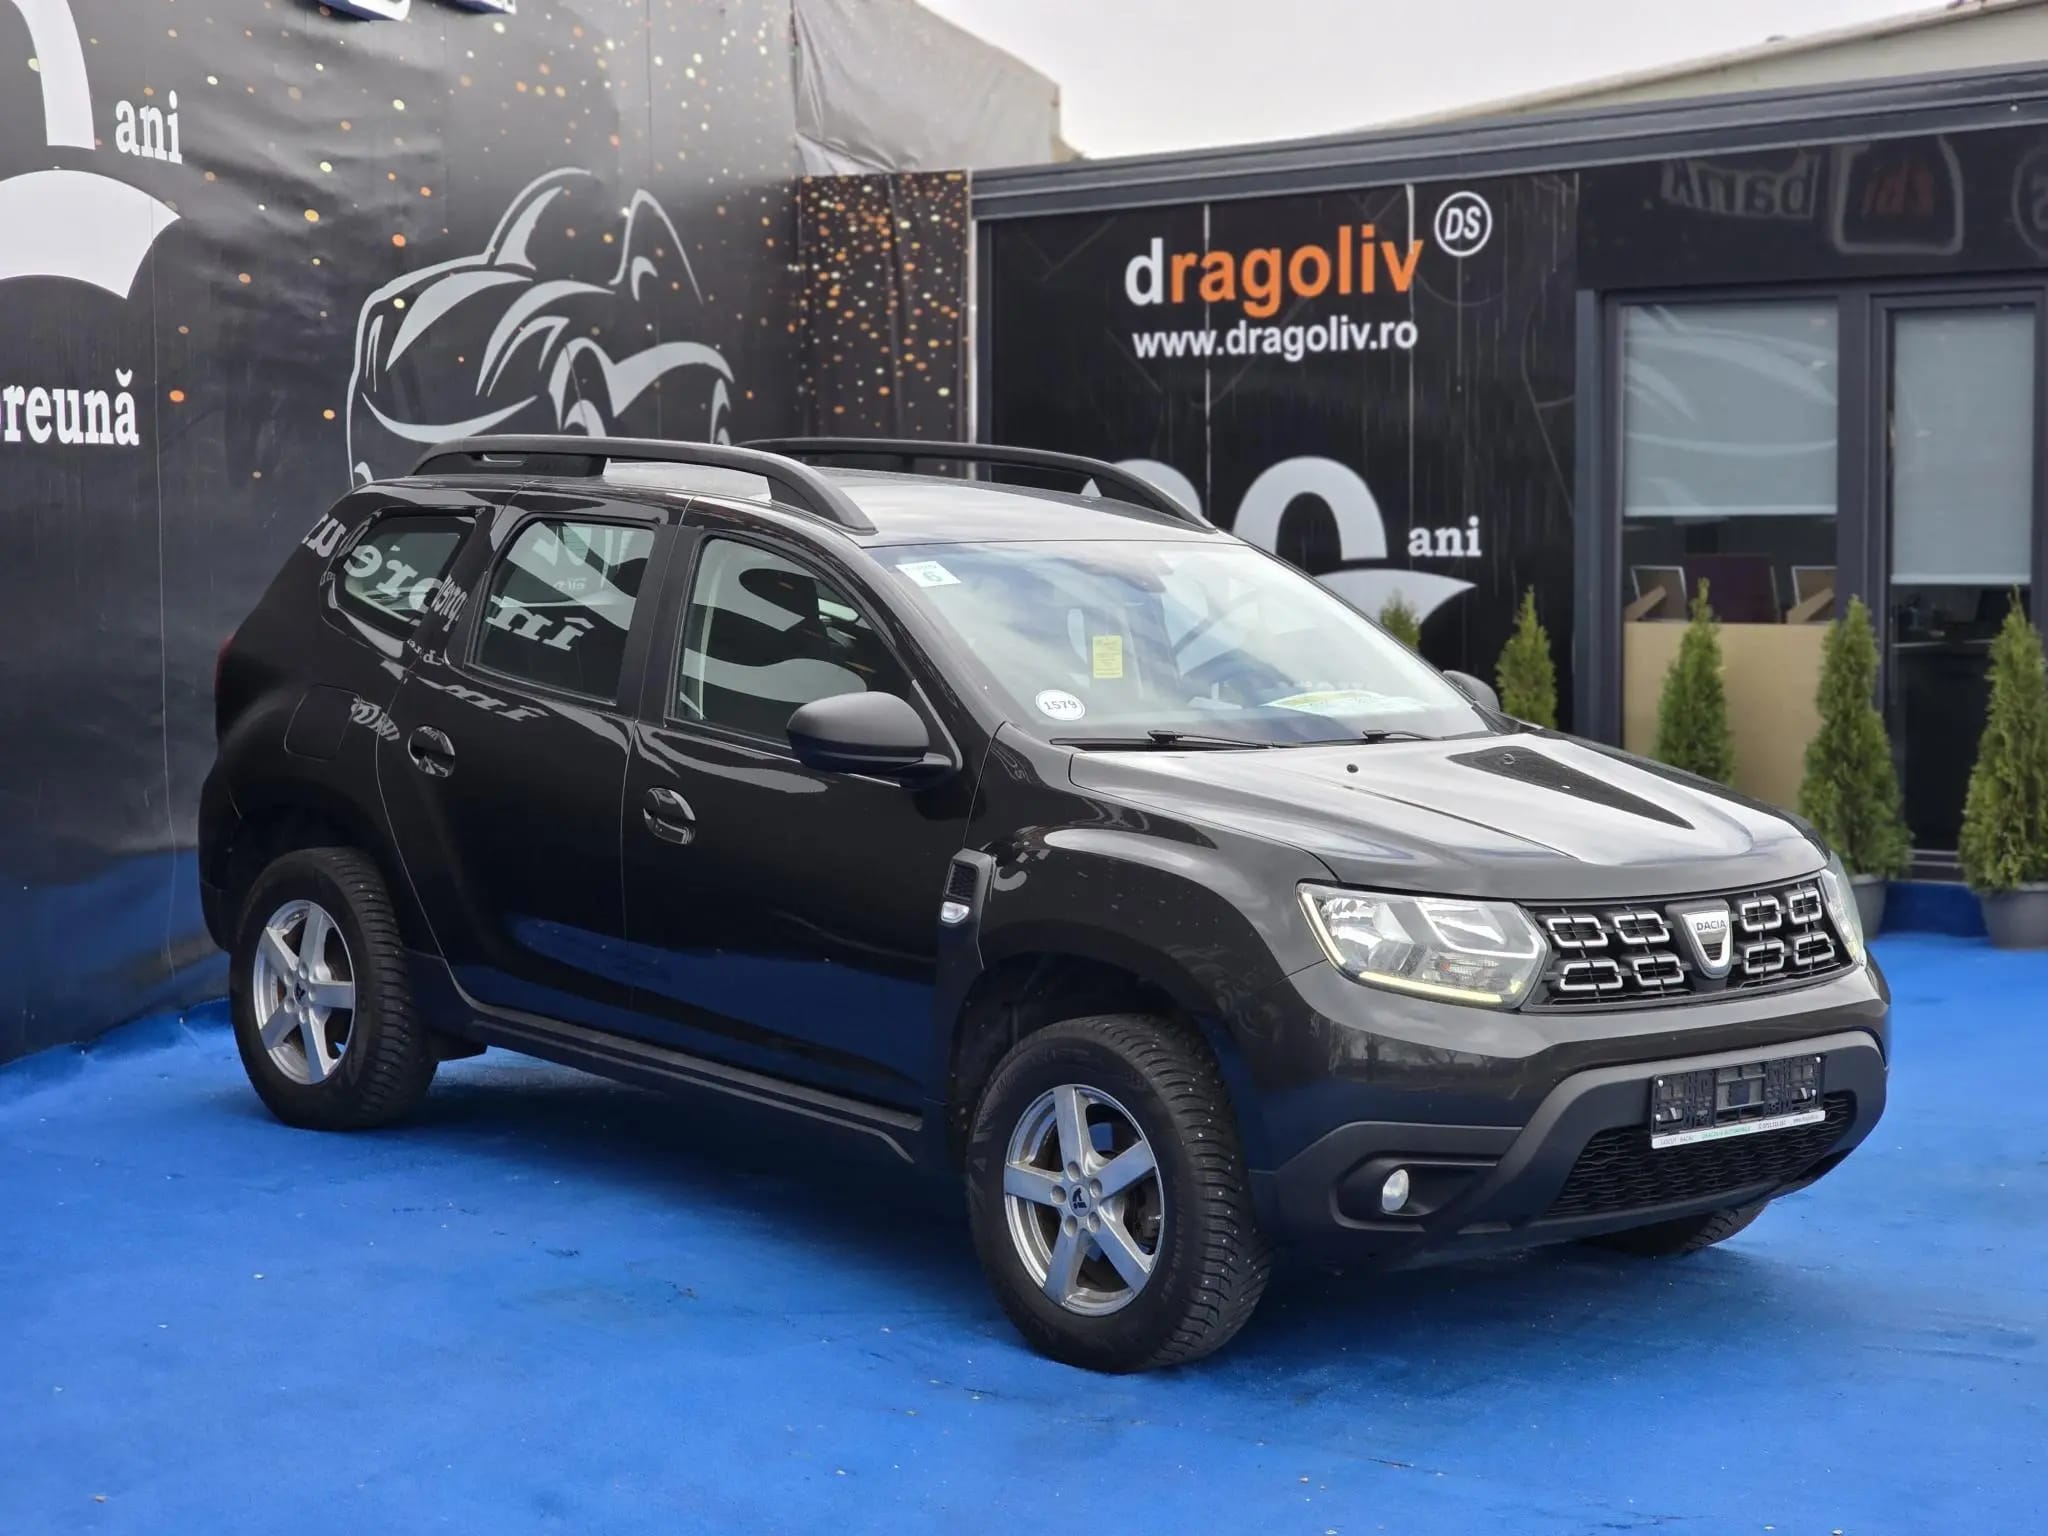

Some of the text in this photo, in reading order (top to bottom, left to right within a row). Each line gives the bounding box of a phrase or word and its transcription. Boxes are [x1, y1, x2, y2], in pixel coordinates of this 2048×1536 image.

[115, 90, 182, 164] ani
[1444, 205, 1482, 241] DS
[1124, 223, 1424, 318] dragoliv
[1132, 315, 1419, 362] www.dragoliv.ro
[1407, 515, 1483, 557] ani
[1043, 699, 1078, 711] 1579
[1695, 919, 1728, 931] DACIA
